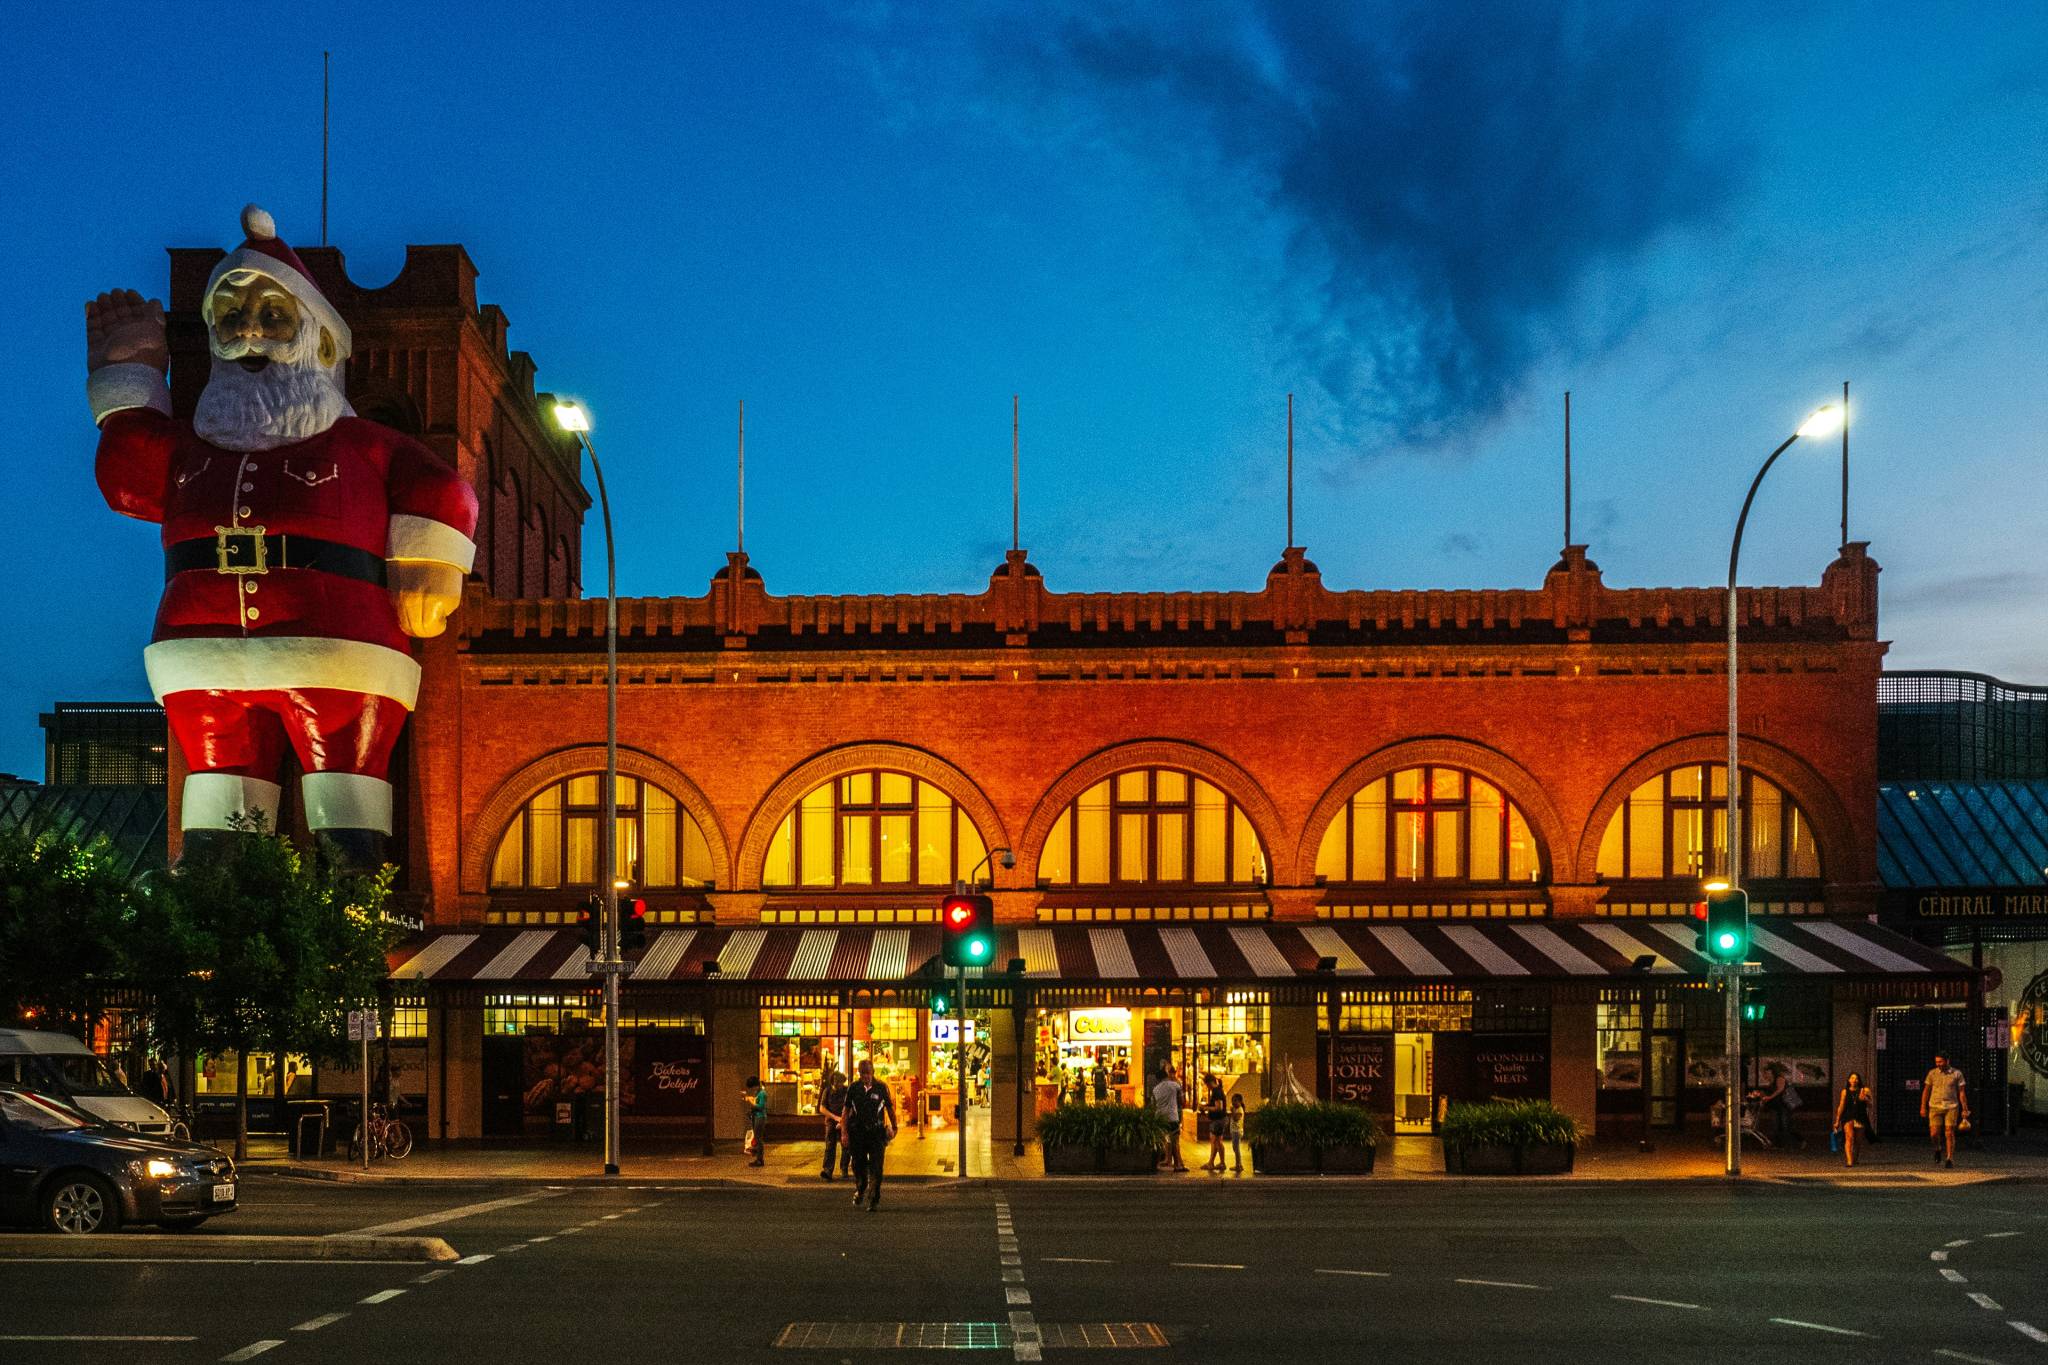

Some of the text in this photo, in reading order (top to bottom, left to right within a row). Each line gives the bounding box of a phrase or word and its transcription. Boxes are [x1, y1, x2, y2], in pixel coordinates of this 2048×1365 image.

[1919, 896, 1994, 916] CENTRAL
[650, 1062, 690, 1077] Bakers
[659, 1076, 698, 1094] Delight
[1494, 1074, 1528, 1083] MEATS
